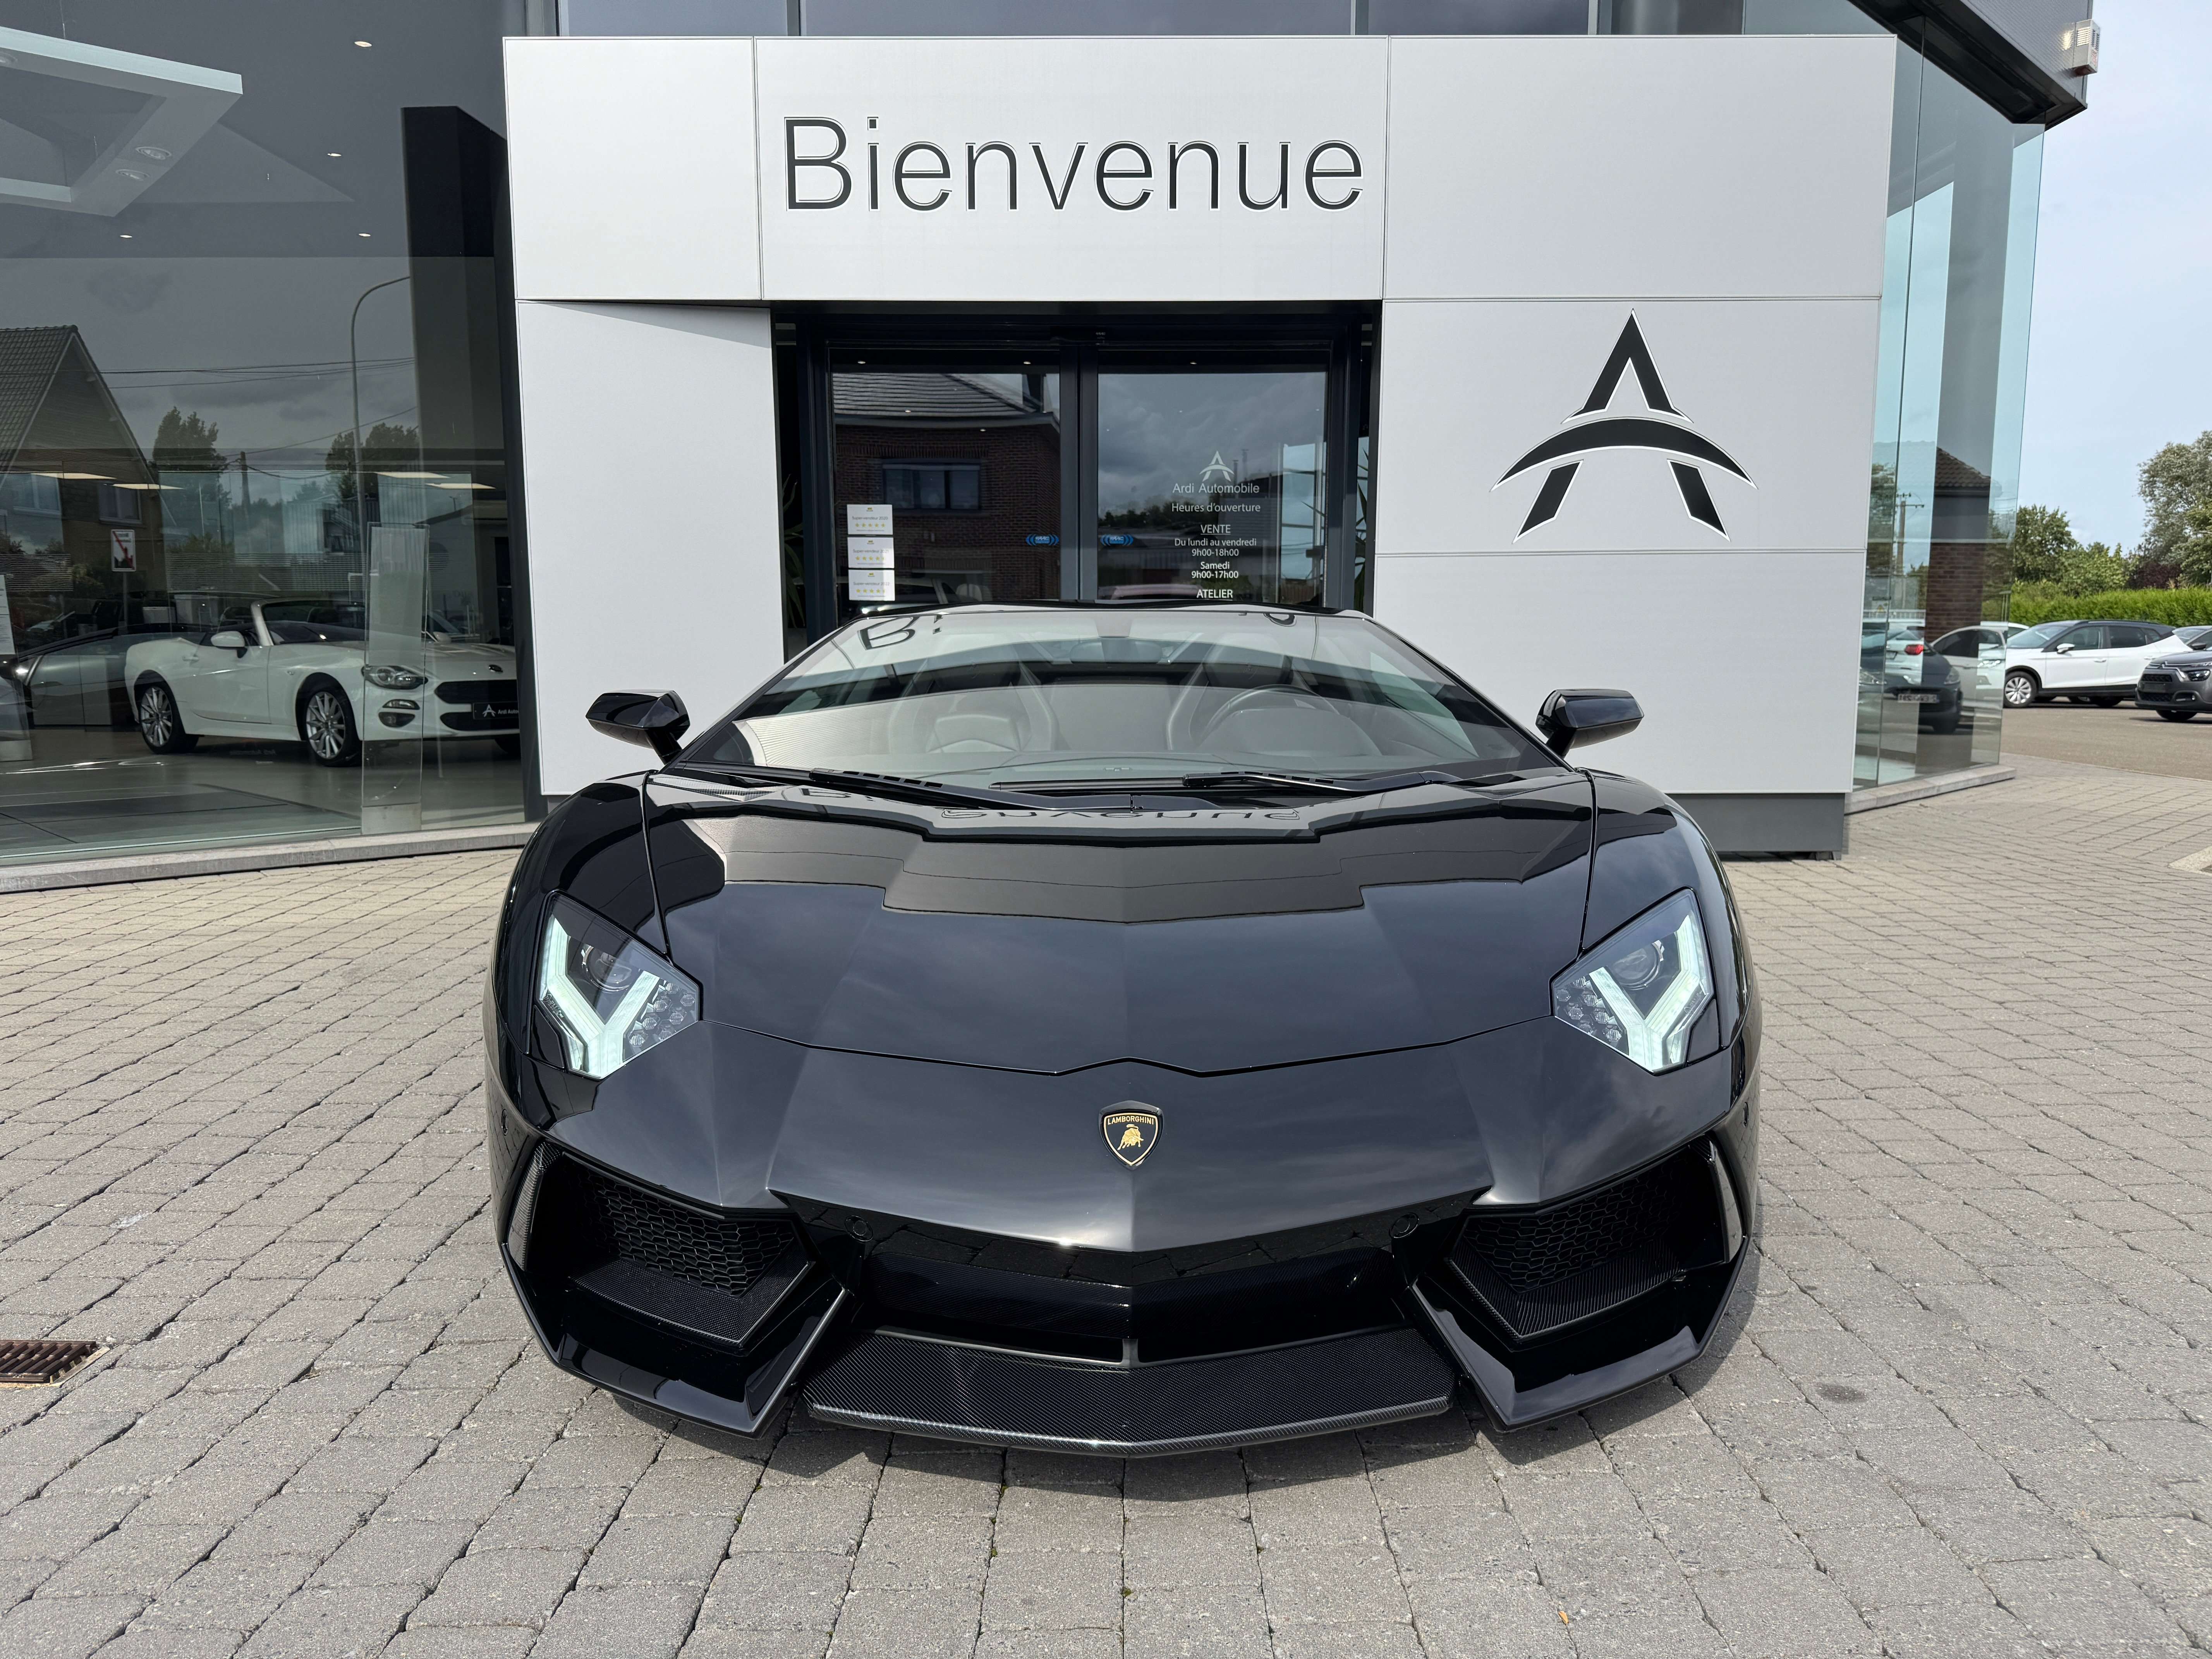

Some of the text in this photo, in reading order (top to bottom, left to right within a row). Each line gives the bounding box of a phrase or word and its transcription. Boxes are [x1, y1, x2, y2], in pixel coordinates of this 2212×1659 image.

[784, 116, 1364, 212] Bienvenue
[1172, 483, 1260, 493] Ardi Automobile
[1171, 502, 1261, 512] Heures d'ouverture
[1200, 524, 1231, 534] VENTE
[1188, 538, 1208, 546] lundi
[1222, 538, 1257, 546] vendredi
[1192, 548, 1239, 556] 9h00-18h00
[1200, 561, 1230, 569] Samedi
[1196, 589, 1233, 598] ATELIER
[1108, 1116, 1154, 1125] LAMBORGHINI
